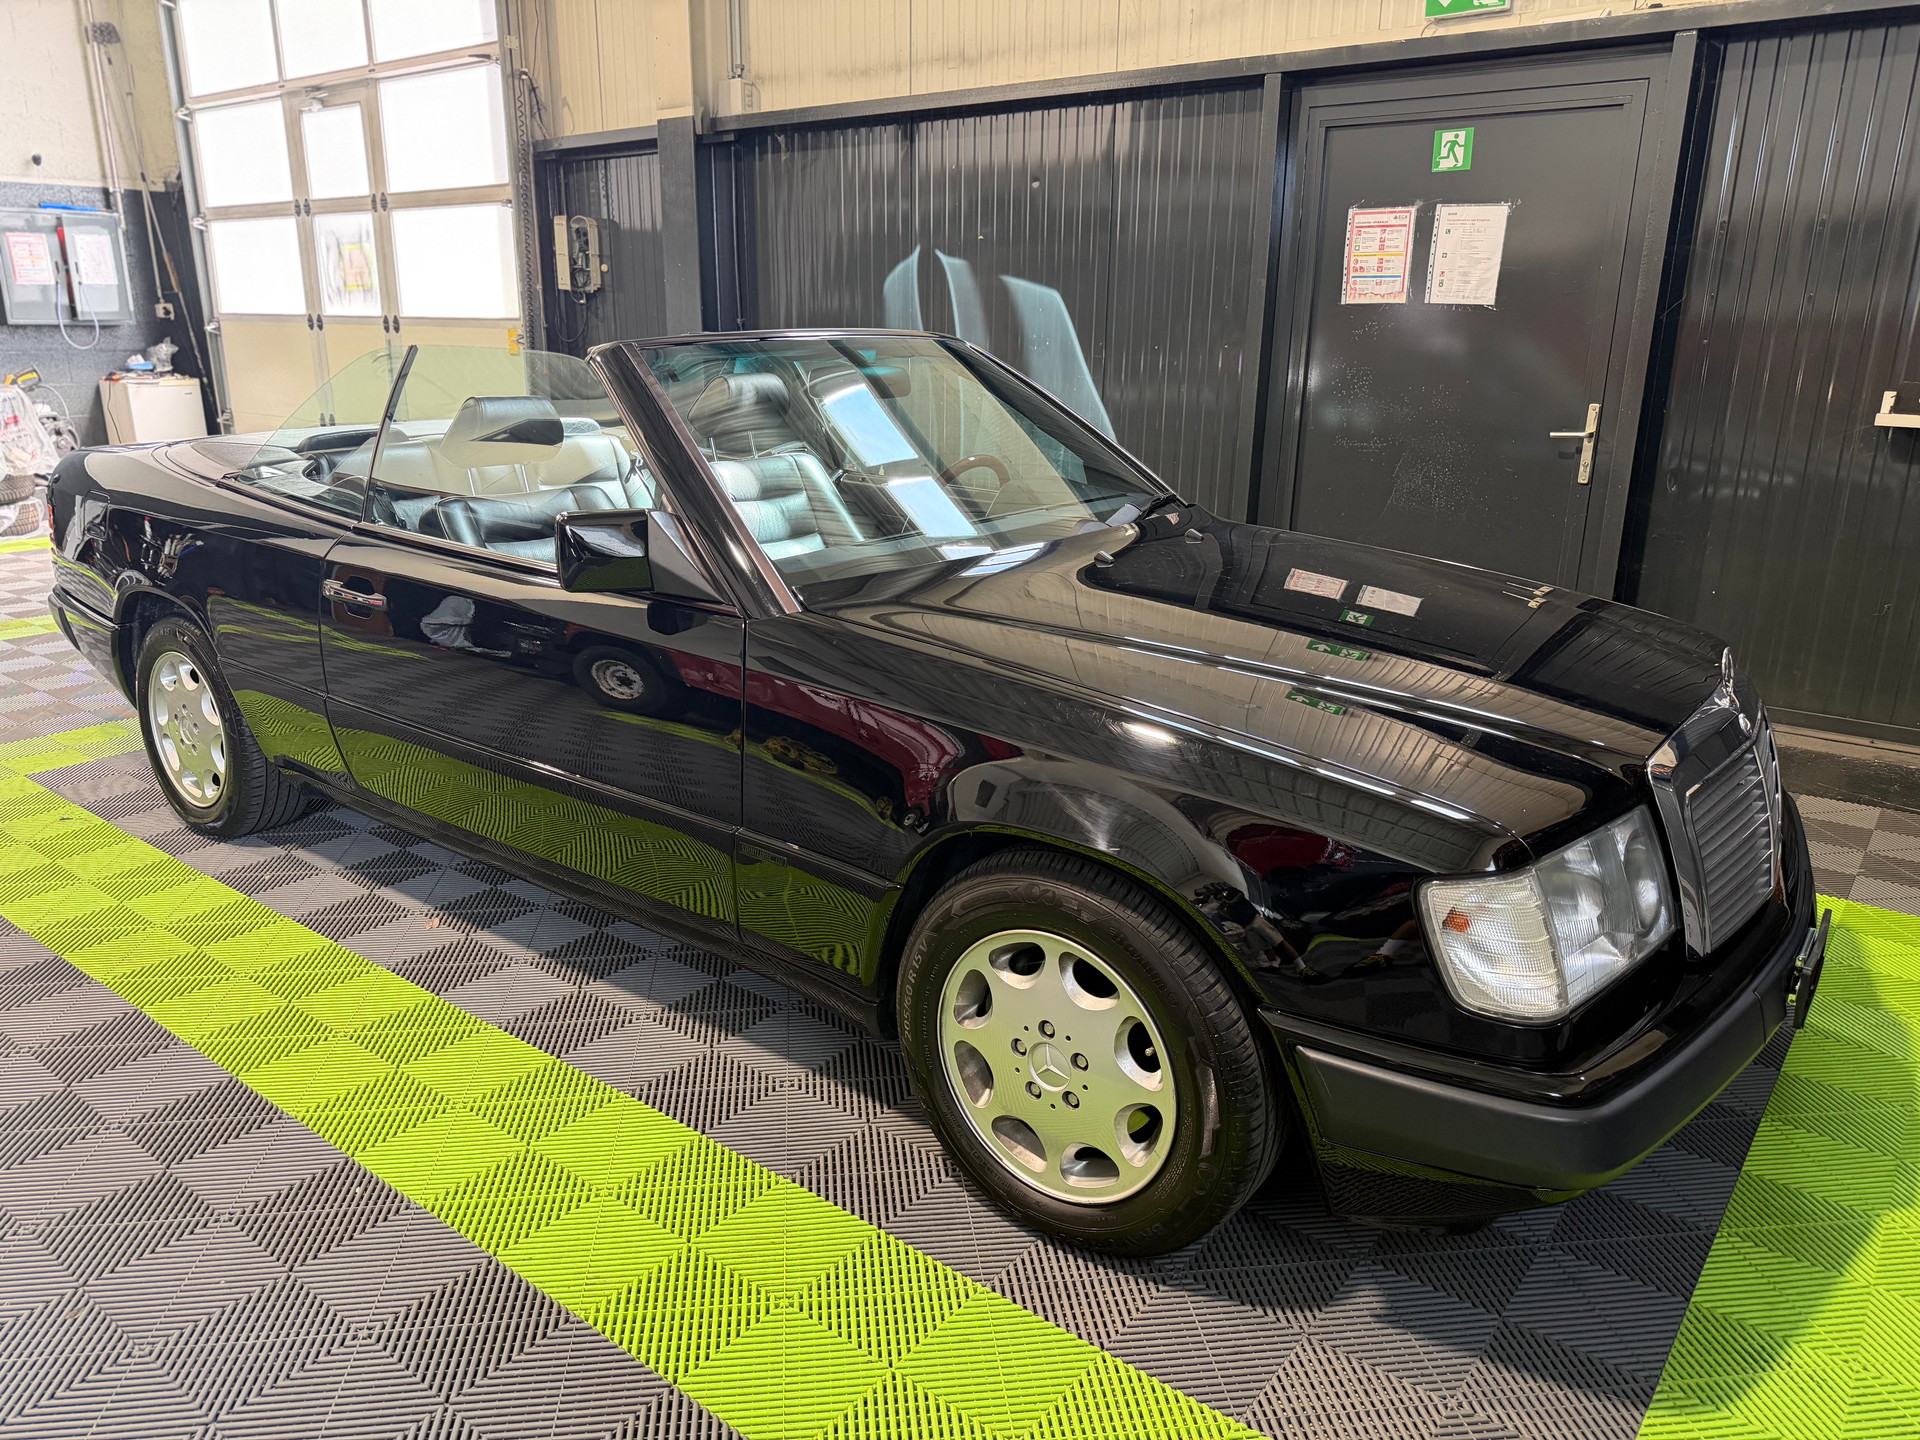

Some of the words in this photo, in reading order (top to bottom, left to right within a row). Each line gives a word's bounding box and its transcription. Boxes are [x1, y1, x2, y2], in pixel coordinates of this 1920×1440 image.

[919, 938, 928, 952] V
[912, 952, 922, 969] 15
[907, 969, 917, 984] R
[903, 984, 913, 1042] 205/60
